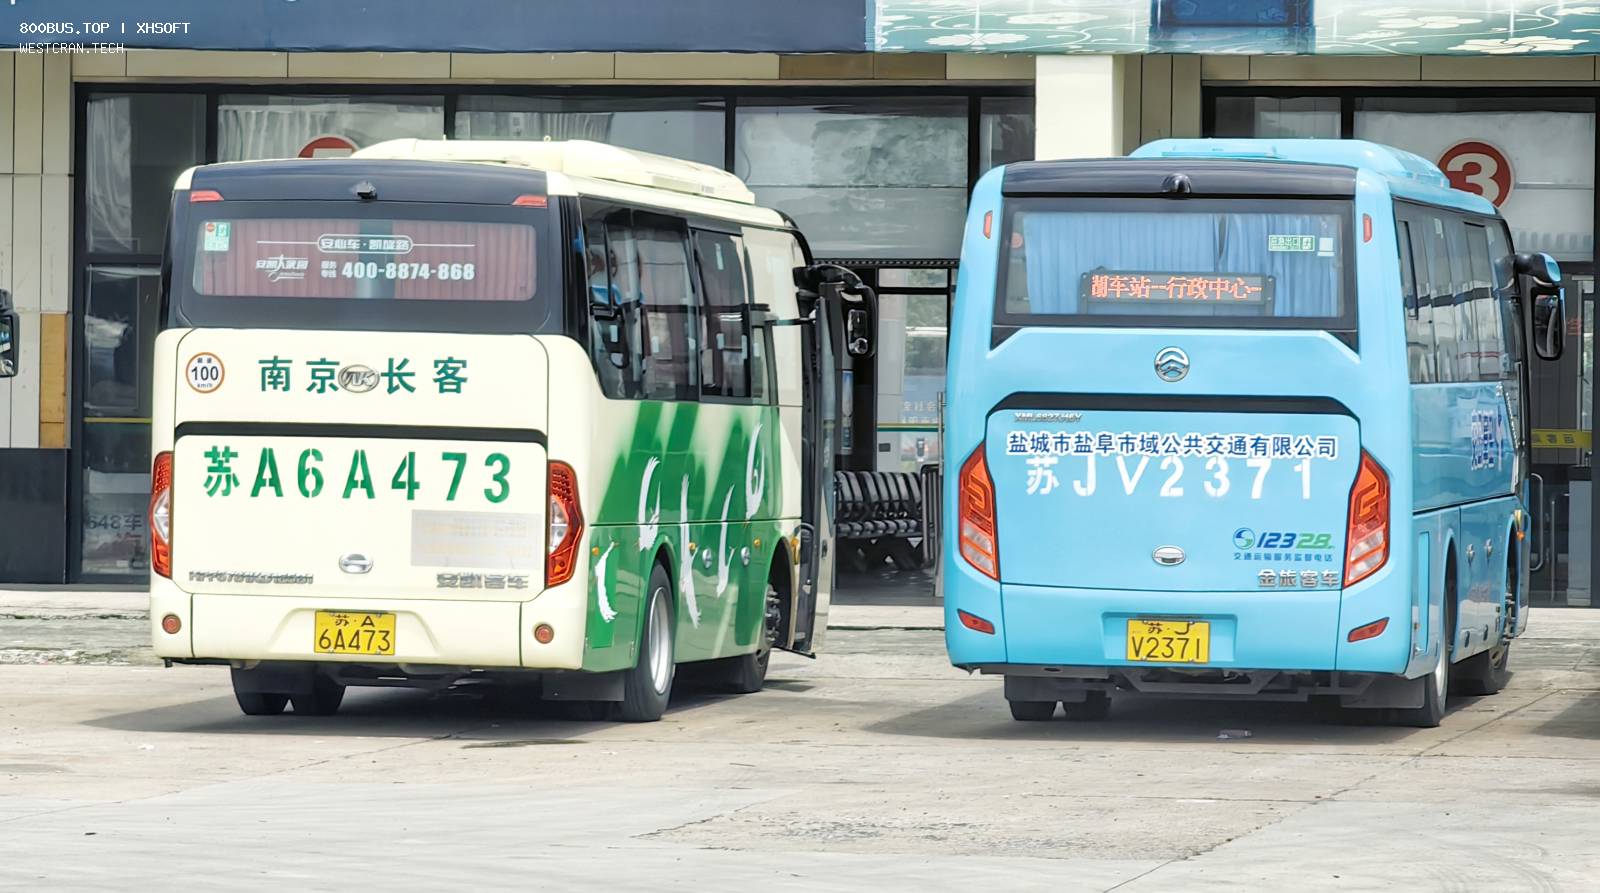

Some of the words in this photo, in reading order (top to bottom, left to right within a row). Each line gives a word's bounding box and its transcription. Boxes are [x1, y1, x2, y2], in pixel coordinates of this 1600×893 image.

[1446, 152, 1500, 207] 3
[341, 261, 475, 281] 400-8874-868
[191, 365, 219, 381] 100
[258, 355, 468, 394] 南京长客
[1007, 432, 1338, 458] 盐城市盐阜市域公共交通有限公司
[203, 445, 512, 504] 苏A6A473
[1025, 455, 1312, 500] 苏JV2371
[1258, 569, 1340, 588] 金旅客车
[319, 628, 391, 652] 6A473
[1132, 636, 1201, 660] V2371
